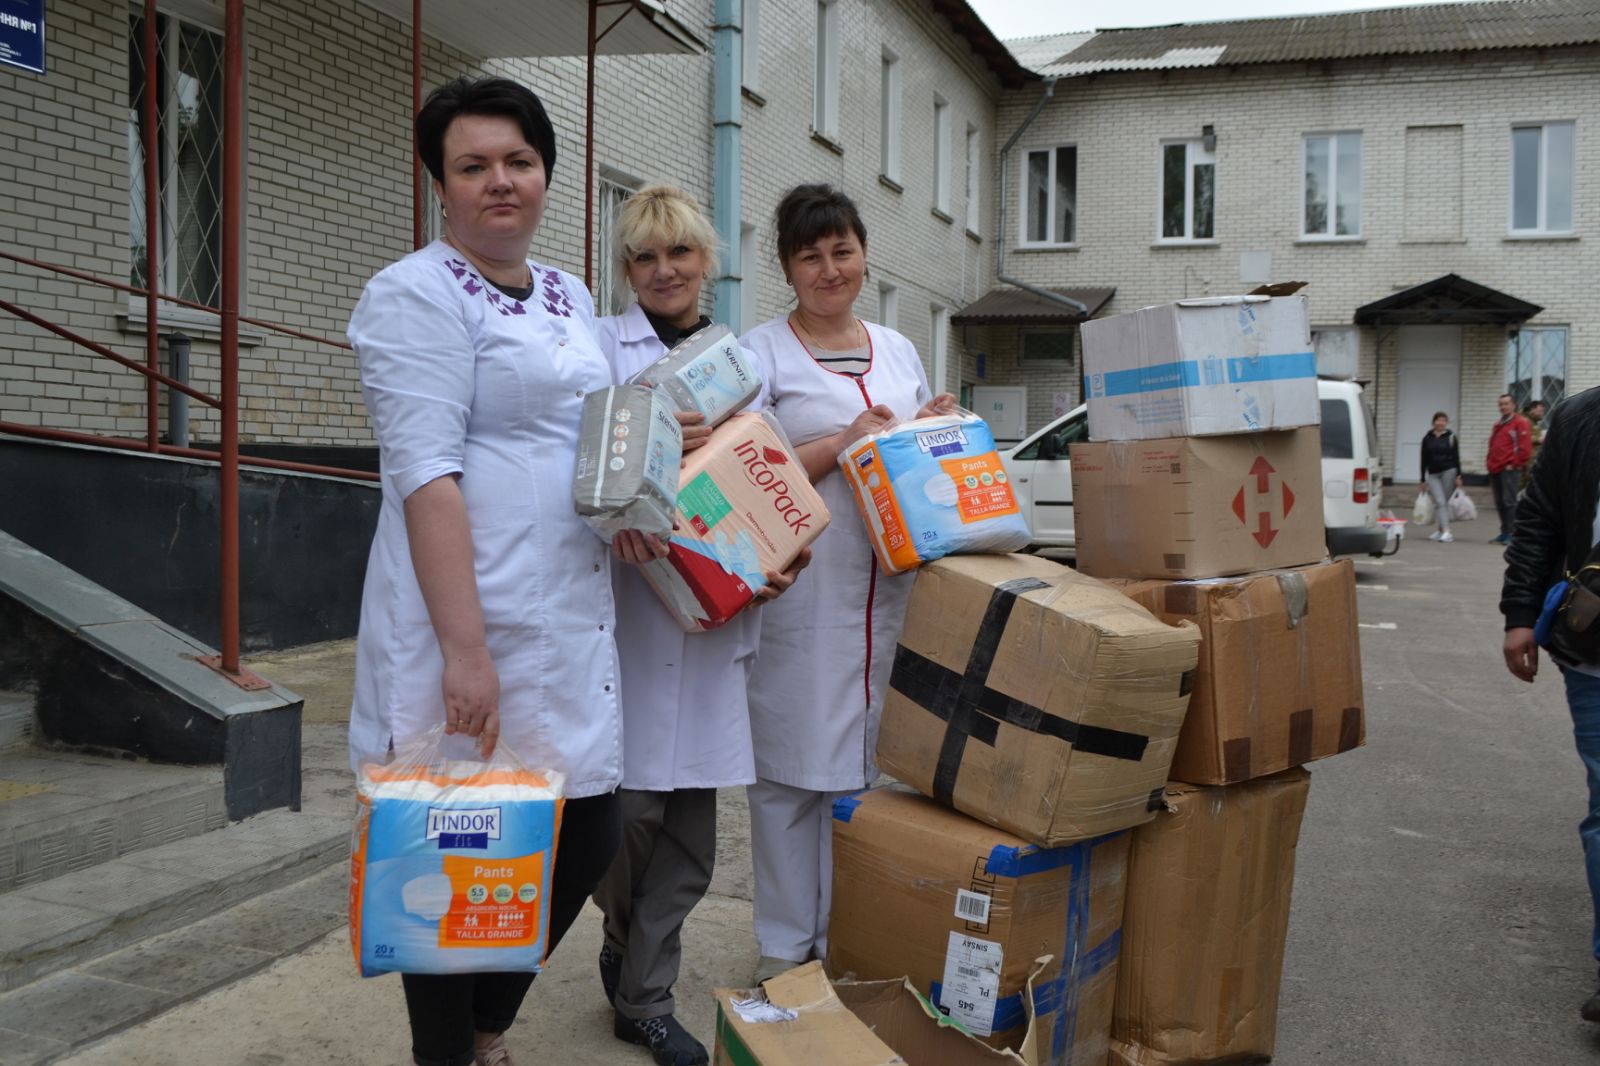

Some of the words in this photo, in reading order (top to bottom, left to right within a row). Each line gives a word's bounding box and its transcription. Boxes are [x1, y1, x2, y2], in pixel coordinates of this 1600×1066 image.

[723, 346, 749, 382] SERENITY
[919, 430, 963, 447] LINDOR
[961, 460, 988, 472] Pants
[733, 439, 813, 536] IncoPack
[922, 530, 932, 540] 20
[433, 814, 496, 831] LINDOR
[474, 865, 514, 878] Pants
[471, 887, 484, 897] 5.5
[456, 930, 486, 939] TALLA
[487, 929, 524, 939] GRANDE
[375, 944, 387, 954] 20
[962, 939, 988, 952] SINSAY
[978, 985, 990, 998] PL
[958, 999, 975, 1012] 545
